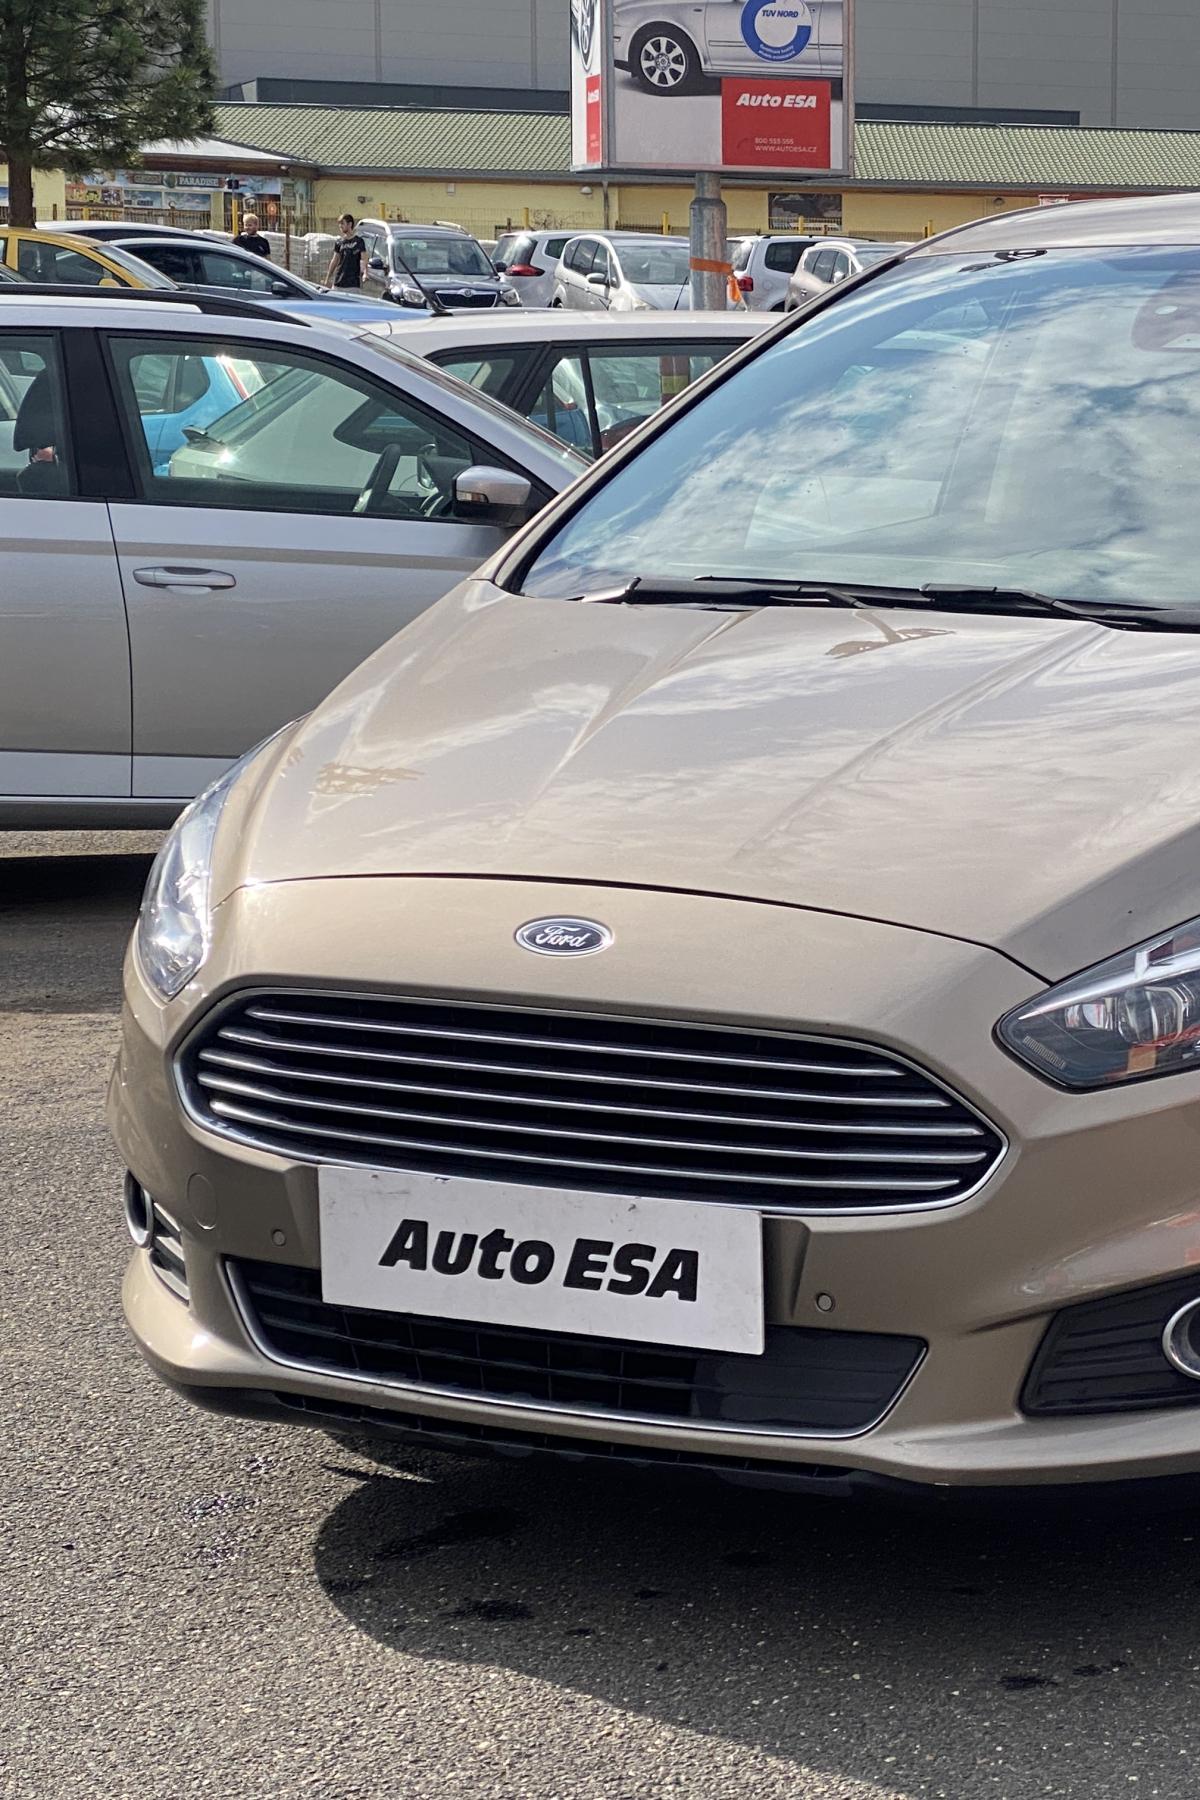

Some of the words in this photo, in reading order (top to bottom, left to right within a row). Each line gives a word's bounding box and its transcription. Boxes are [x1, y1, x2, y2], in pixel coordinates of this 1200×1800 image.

[762, 9, 776, 17] TÜV
[777, 10, 799, 18] NORD
[736, 93, 782, 107] Auto
[783, 94, 817, 108] ESA
[754, 145, 817, 153] WWW.AUTOESA.CZ
[179, 177, 219, 186] PARADISE
[535, 925, 590, 948] Ford
[379, 1219, 555, 1285] Auto
[562, 1238, 700, 1302] ESA
